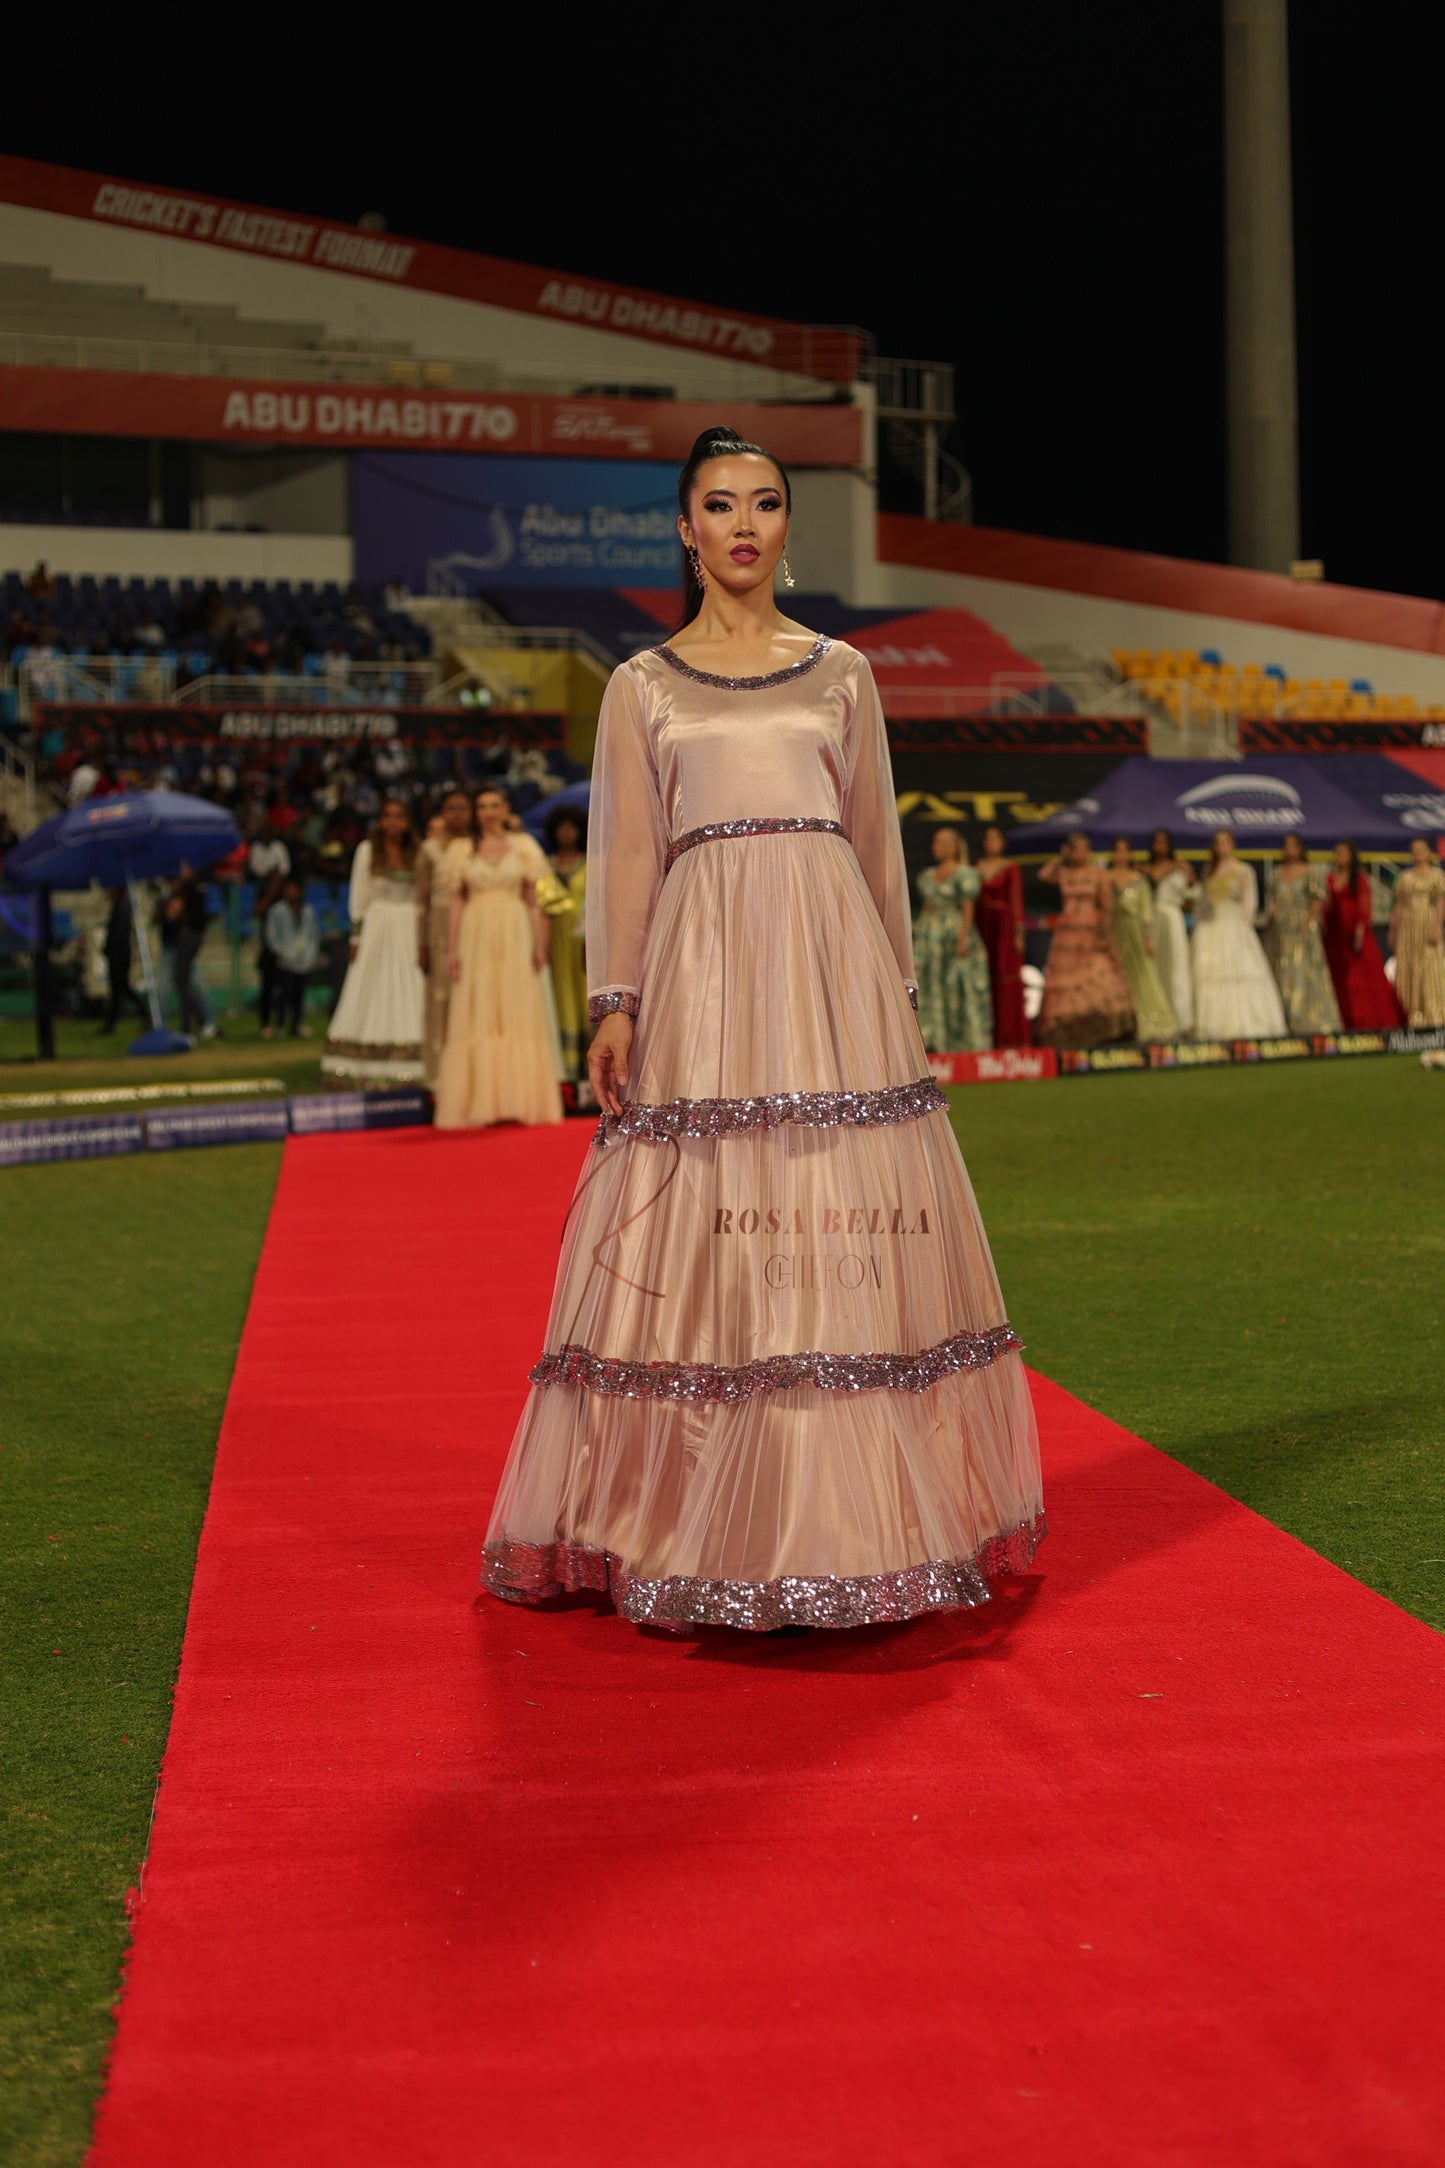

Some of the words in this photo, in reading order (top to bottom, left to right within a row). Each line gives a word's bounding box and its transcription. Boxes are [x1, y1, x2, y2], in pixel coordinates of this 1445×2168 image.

[93, 183, 220, 237] CRICKET'S
[215, 208, 318, 257] FASTEST
[312, 229, 416, 278] FORMAT
[537, 280, 612, 321] ABU
[223, 390, 311, 433] ABU
[520, 504, 585, 537] Abu
[220, 712, 272, 738] ABU
